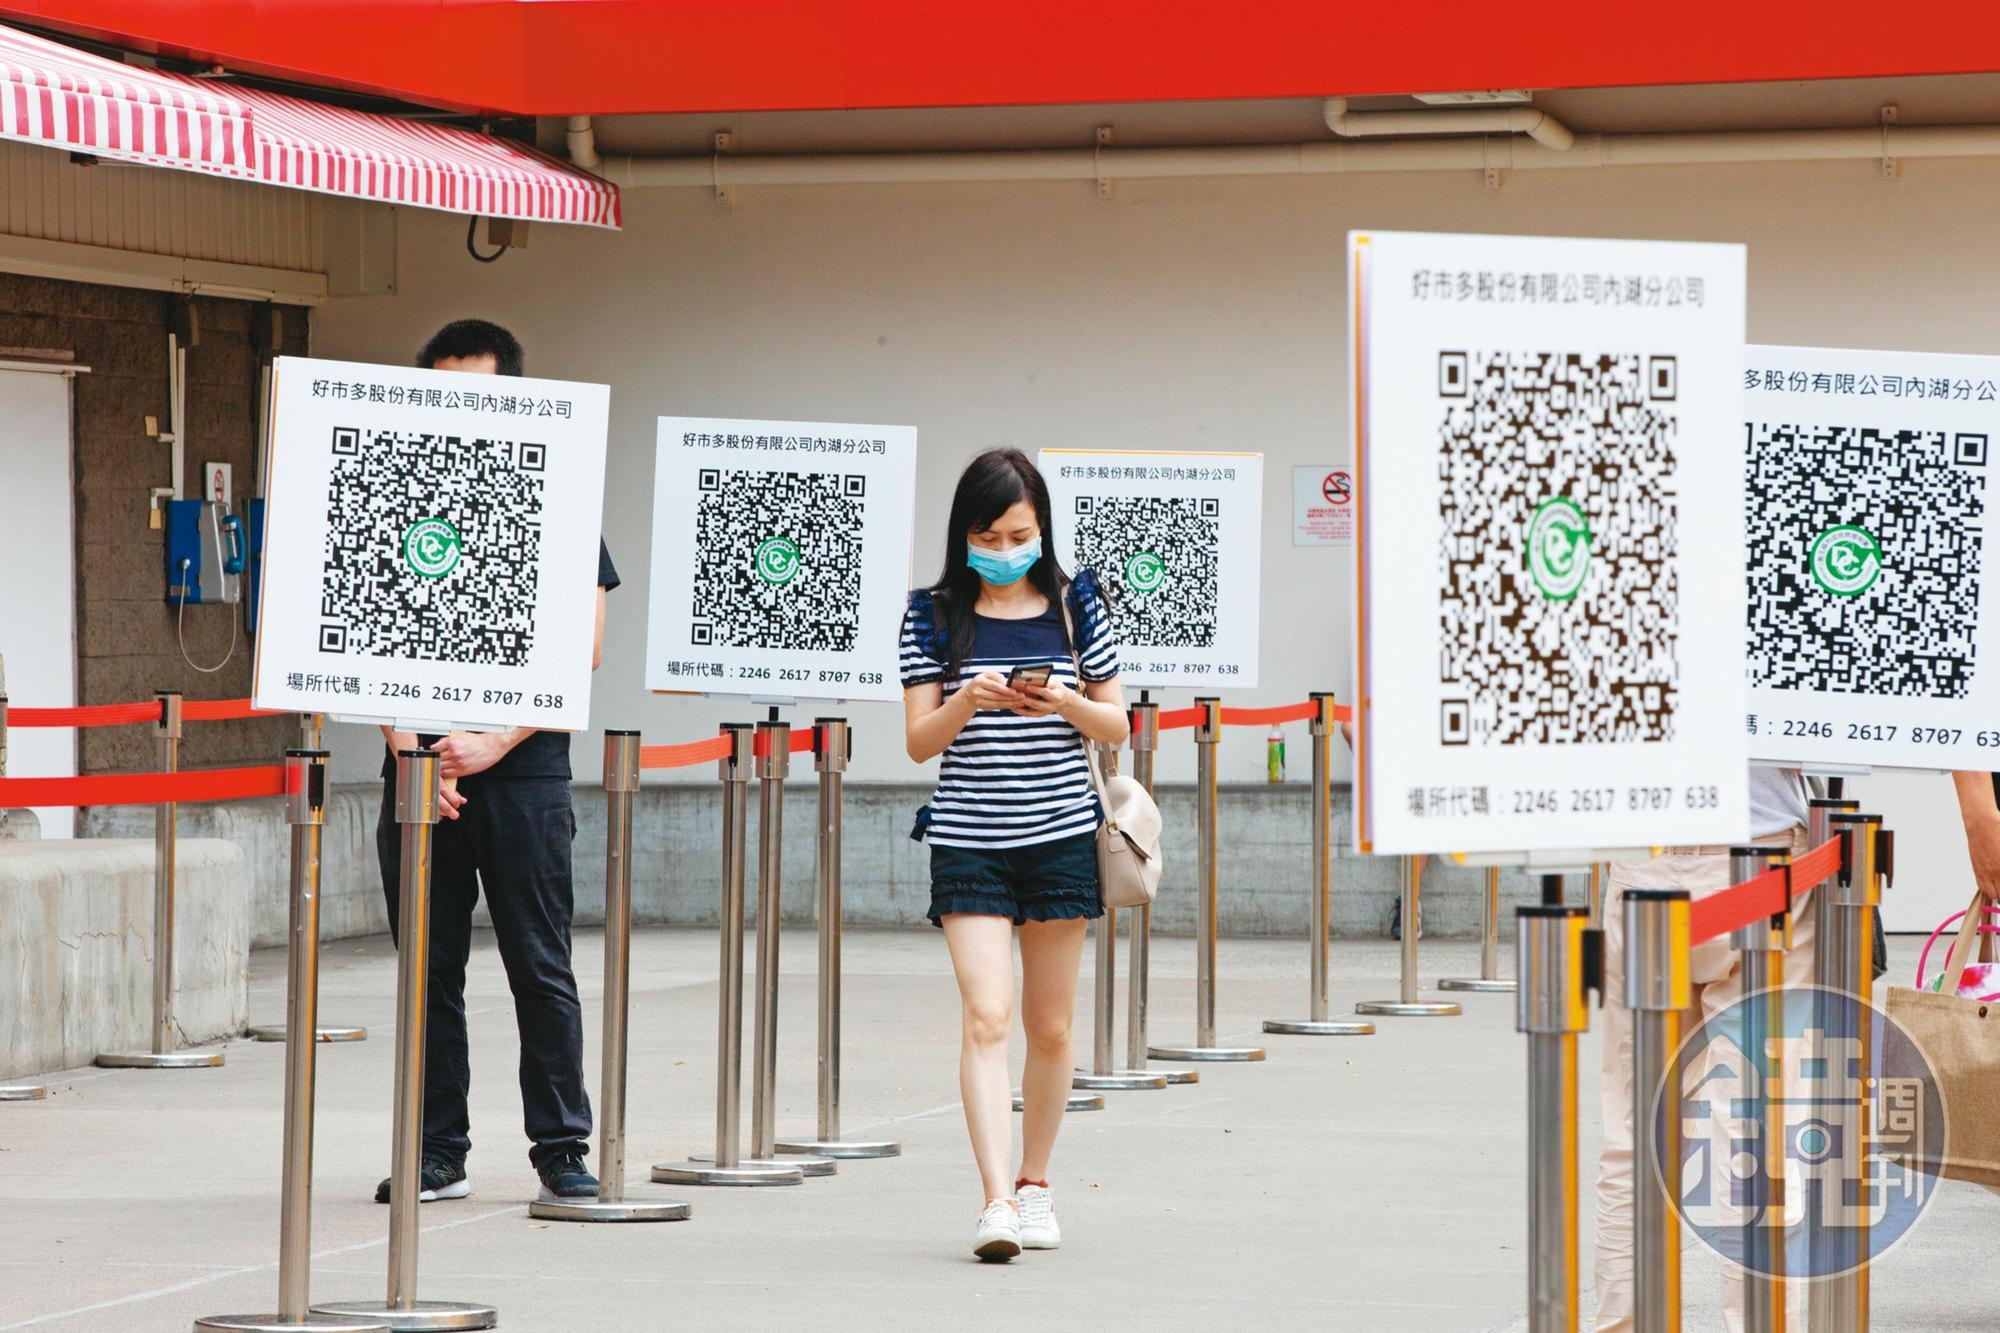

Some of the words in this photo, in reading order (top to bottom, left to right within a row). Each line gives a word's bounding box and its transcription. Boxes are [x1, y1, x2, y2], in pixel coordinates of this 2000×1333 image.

[1411, 269, 1705, 308] 好市多股份有限公司內湖分公司
[1744, 368, 1998, 401] 多股份有限公司內湖分公
[312, 379, 573, 419] 好市多股份有限公司內湖分公司
[683, 432, 886, 455] 好市多股份有限公司內湖分公司
[1060, 465, 1236, 481] 好市多股份有限公司內湖分公司
[738, 666, 771, 680] 2246
[779, 668, 811, 681] 2617
[818, 670, 851, 683] 8707
[858, 672, 883, 685] 638
[1120, 662, 1143, 673] 246
[1149, 662, 1177, 673] 2617
[1183, 663, 1212, 675] 8707
[1218, 664, 1239, 675] 638
[380, 682, 421, 699] 2246
[431, 686, 472, 702] 2617
[482, 690, 523, 706] 8707
[533, 693, 563, 709] 638
[1782, 719, 1833, 739] 2246
[1847, 723, 1898, 742] 2617
[1911, 727, 1962, 745] 8707
[1976, 730, 2000, 748] 63
[1513, 789, 1559, 814] 2246
[1571, 787, 1616, 812] 2617
[1628, 786, 1673, 811] 8707
[1685, 785, 1719, 809] 638
